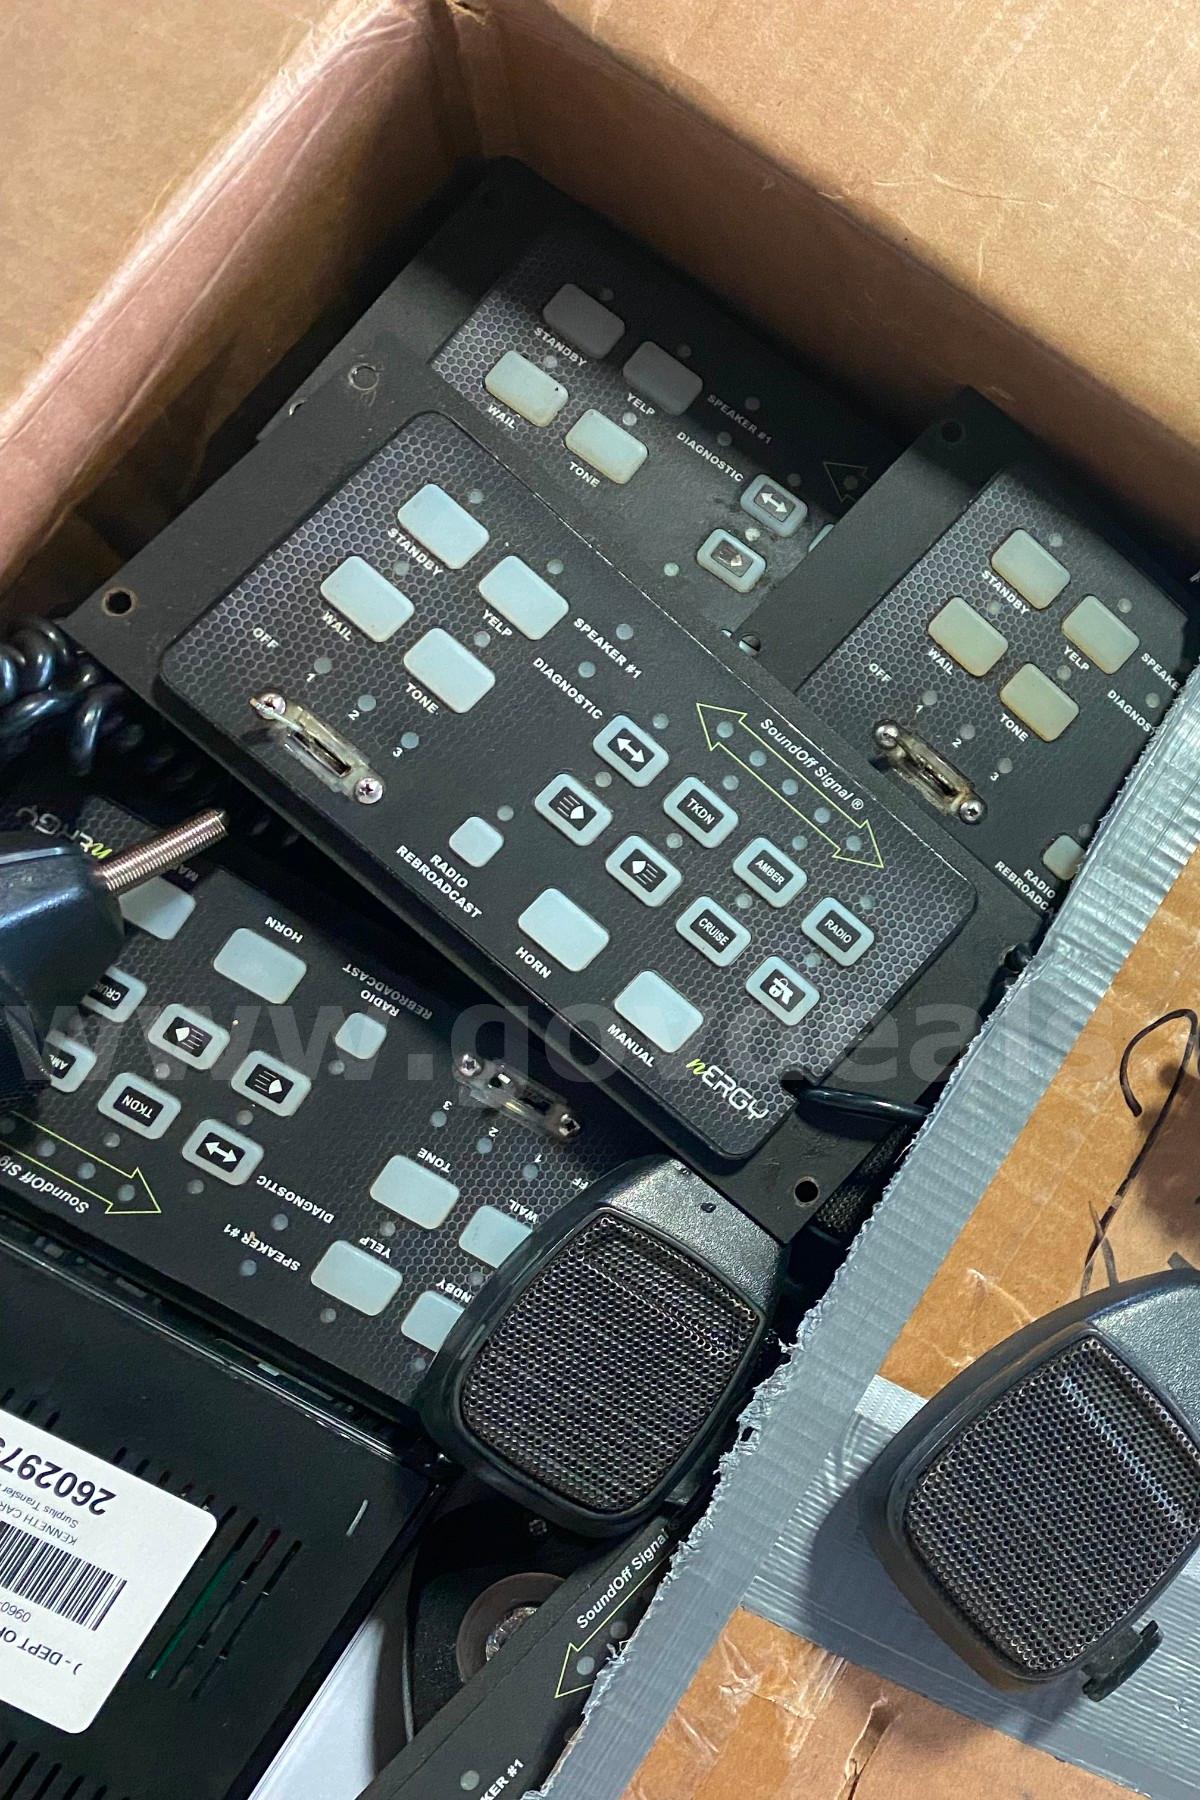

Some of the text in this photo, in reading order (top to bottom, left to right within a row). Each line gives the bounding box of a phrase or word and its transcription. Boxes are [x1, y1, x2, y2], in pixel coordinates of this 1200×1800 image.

[533, 326, 588, 369] STANDBY
[487, 404, 517, 430] WAIL
[626, 393, 656, 417] YELP
[706, 394, 774, 446] SPEAKER #1
[675, 430, 745, 484] DIAGNOSTIC
[568, 461, 601, 488] TONE
[387, 527, 444, 578] STANDBY
[981, 569, 1031, 616] STANDBY
[321, 611, 353, 642] WAIL
[482, 608, 513, 638] YELP
[252, 626, 279, 650] OFF
[572, 617, 643, 680] SPEAKER #1
[868, 662, 892, 684] OFF
[927, 647, 954, 677] WAIL
[1062, 645, 1091, 673] YELP
[306, 672, 316, 683] 1
[532, 656, 604, 721] DIAGNOSTIC
[404, 683, 438, 714] TONE
[915, 703, 925, 714] 1
[347, 709, 361, 721] 2
[1000, 712, 1029, 744] TONE
[392, 747, 404, 759] 3
[951, 737, 962, 749] 2
[760, 718, 820, 770] SoundOff
[814, 763, 857, 803] Signal
[990, 771, 1000, 782] 3
[686, 797, 716, 826] TKDN
[395, 845, 483, 919] REBROADCAST
[429, 854, 469, 889] RADIO
[754, 858, 786, 886] AMBER
[1023, 868, 1057, 900] RADIO
[264, 915, 304, 944] HORN
[697, 916, 730, 947] CRUISE
[823, 918, 853, 945] RADIO
[515, 946, 552, 980] HORN
[341, 961, 434, 1021] REBROADCAST
[359, 989, 400, 1018] RADIO
[607, 1023, 656, 1068] MANUAL
[686, 1057, 770, 1120] nERGY
[122, 1094, 154, 1120] TKDN
[442, 1099, 453, 1111] 3
[487, 1126, 499, 1138] 2
[417, 1147, 452, 1174] TONE
[534, 1153, 544, 1163] 1
[18, 1171, 90, 1214] SoundOff
[571, 1177, 590, 1191] FF
[255, 1174, 336, 1225] DIAGNOSTIC
[509, 1198, 540, 1225] WAIL
[222, 1223, 301, 1272] SPEAKER #1
[358, 1235, 394, 1258] YELP
[434, 1278, 475, 1304] NDBY
[1, 1483, 79, 1529] Surplus Transfer
[25, 1515, 79, 1547] KENNETH
[576, 1527, 670, 1629] SoundOff Signal
[17, 1637, 64, 1666] DEPT
[505, 1758, 525, 1778] #1
